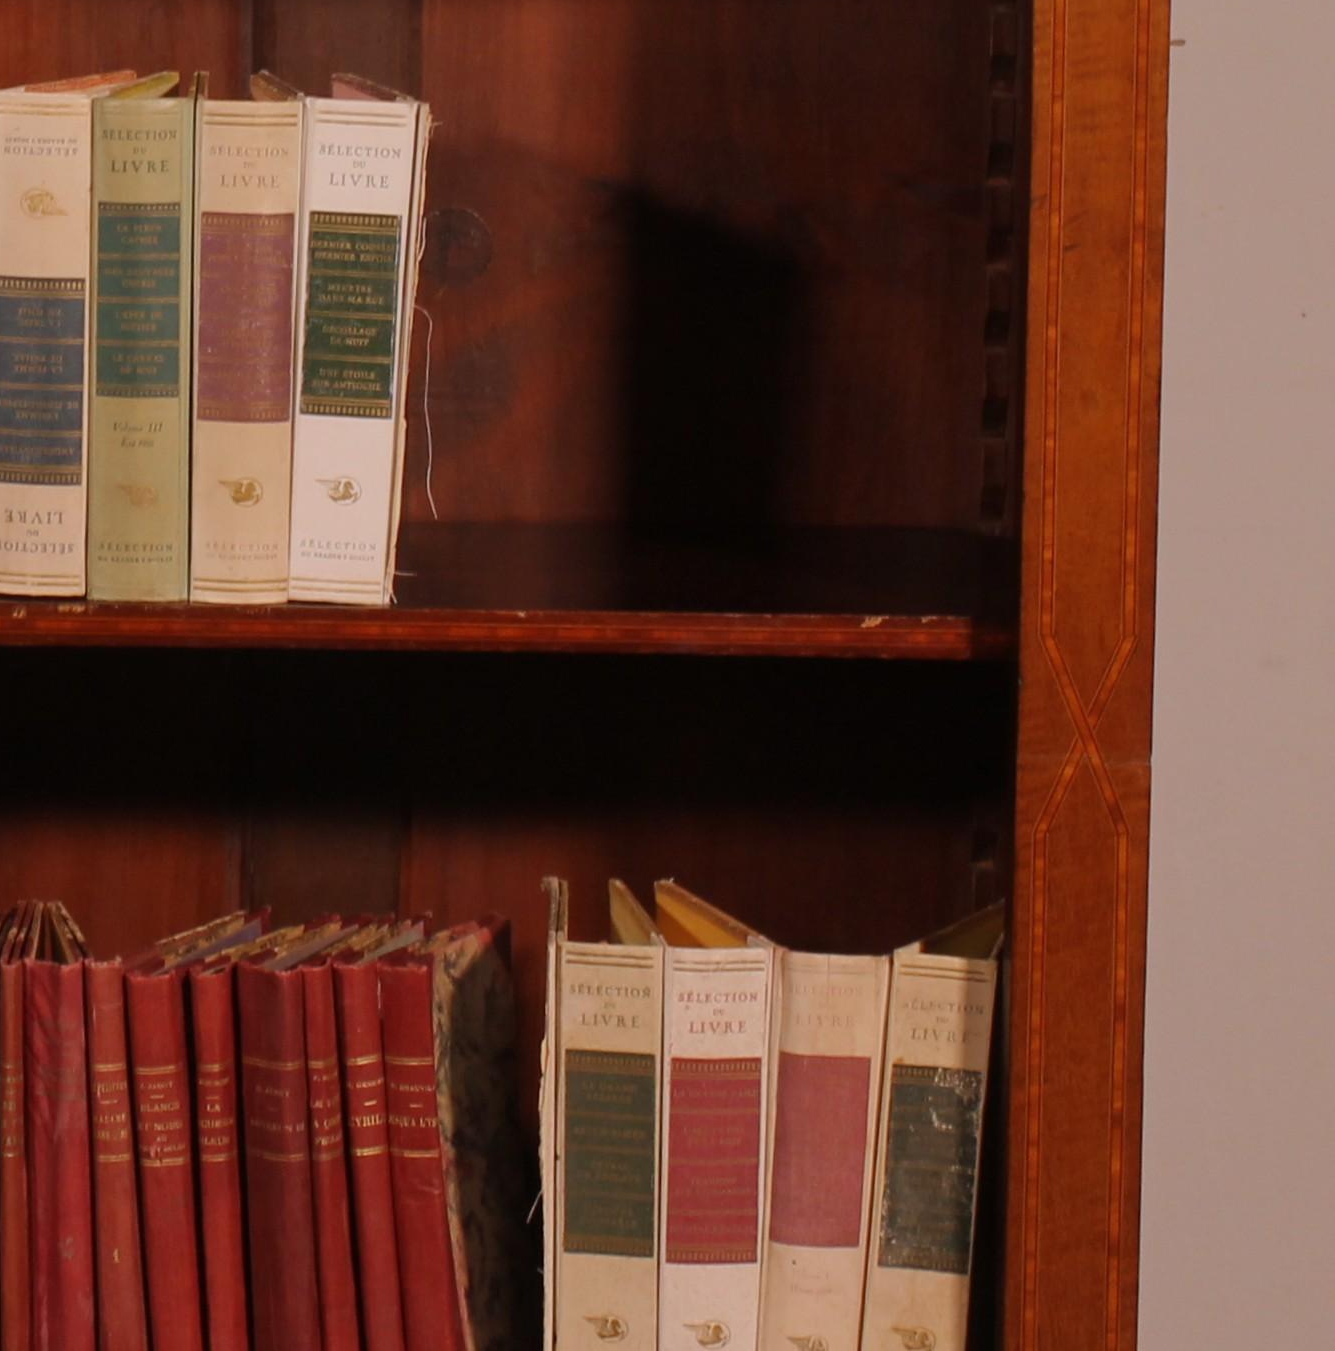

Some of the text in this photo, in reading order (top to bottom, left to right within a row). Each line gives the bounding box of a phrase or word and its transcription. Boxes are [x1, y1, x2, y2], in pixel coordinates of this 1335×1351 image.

[102, 128, 177, 141] SÉLECTION
[209, 145, 289, 158] SÉLECTION
[319, 144, 402, 159] SÉLECTION
[111, 159, 170, 174] LIVRE
[353, 161, 365, 169] DU
[219, 174, 280, 189] LIVRE
[328, 174, 389, 190] LIVRE
[5, 509, 63, 525] LIVRE
[569, 984, 651, 999] SÉLECTION
[678, 990, 758, 1003] SÉLECTION
[580, 1013, 640, 1029] LIVRE
[689, 1021, 747, 1034] LIVRE
